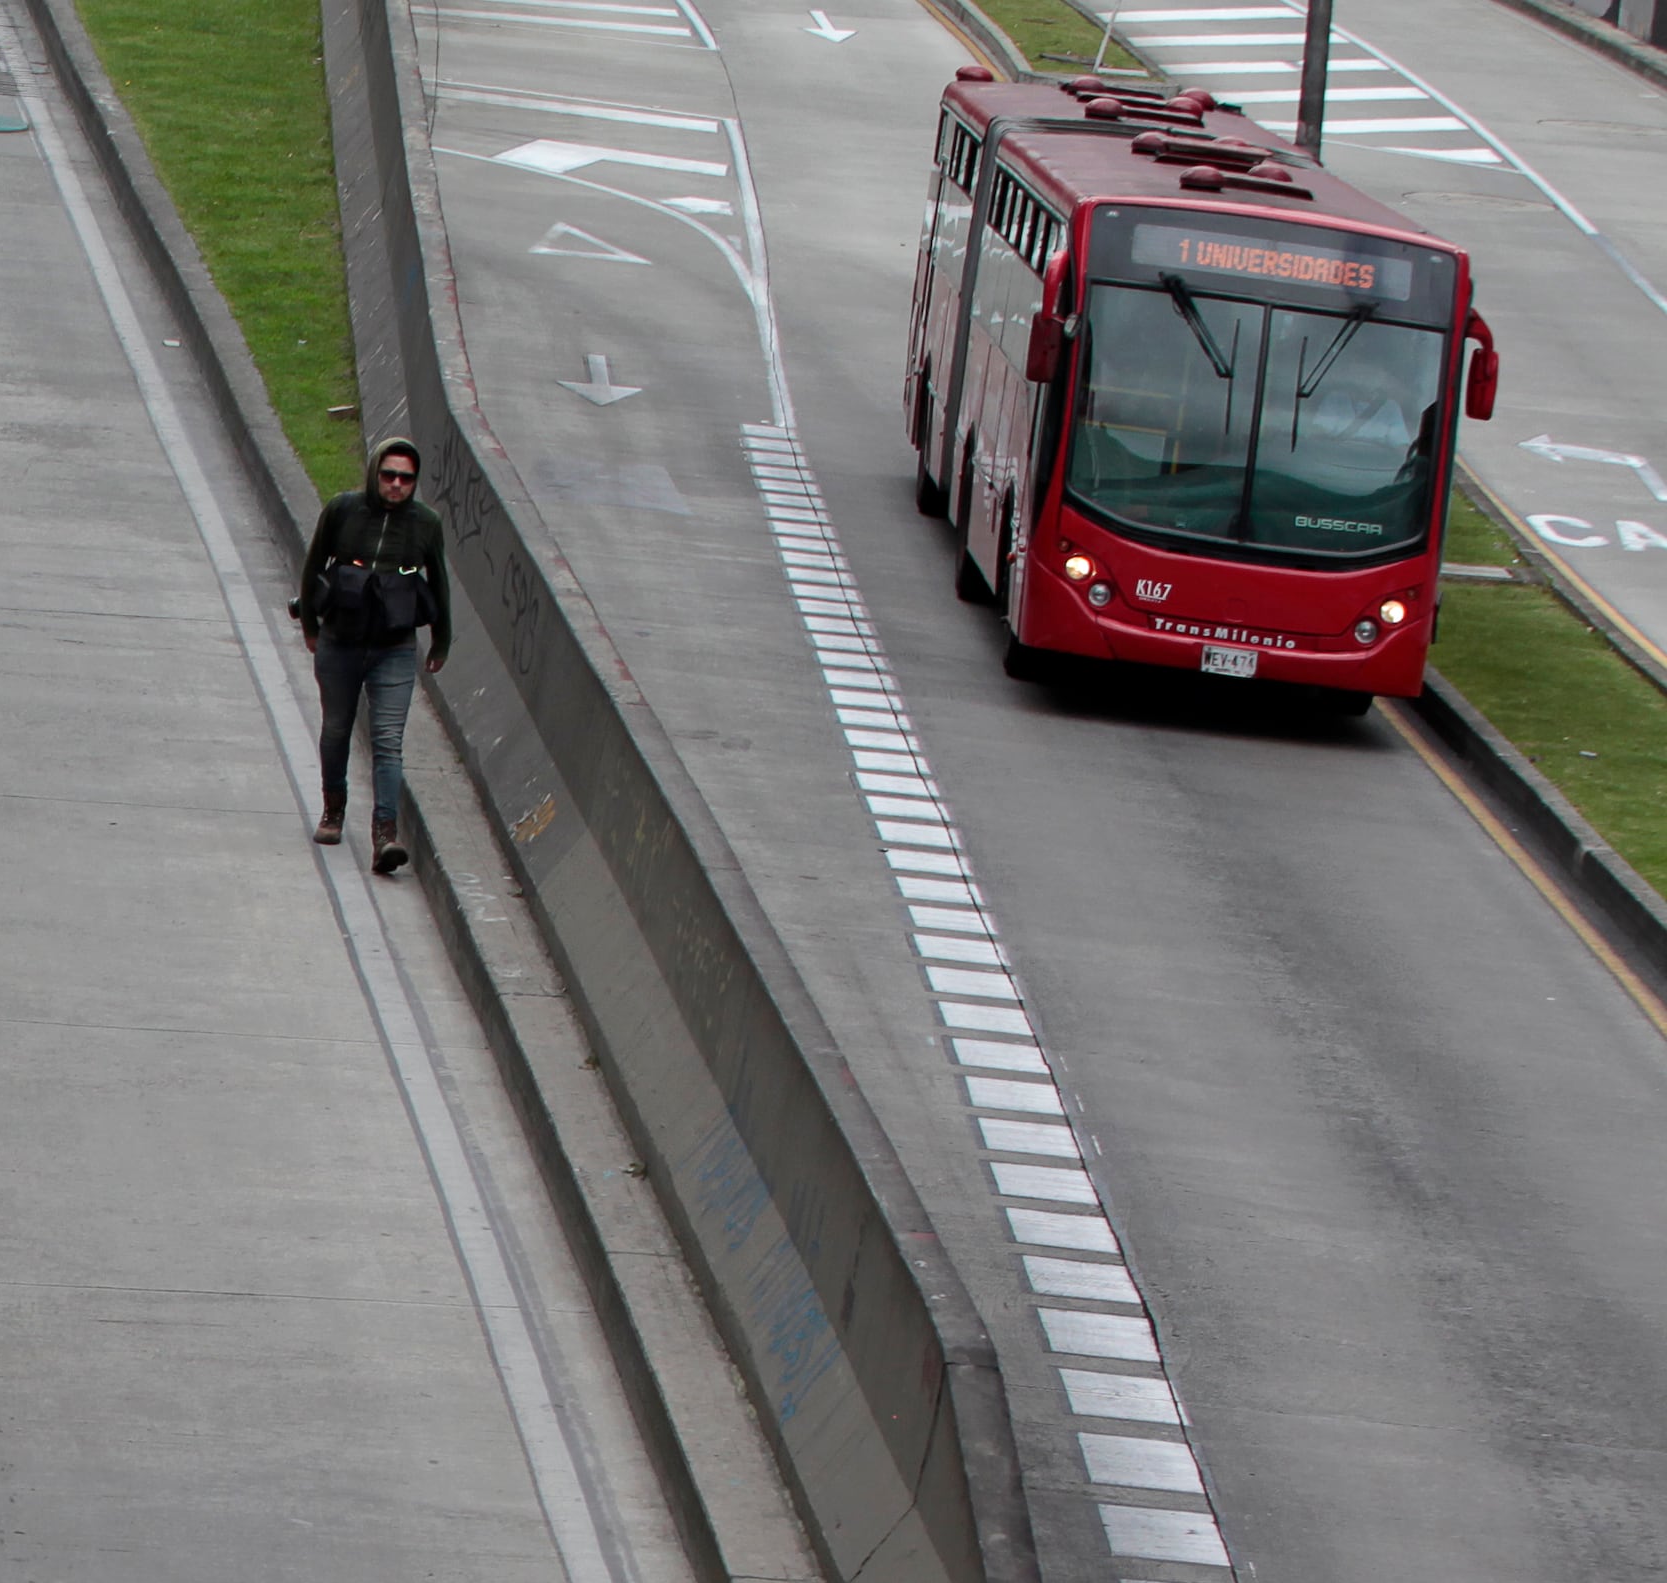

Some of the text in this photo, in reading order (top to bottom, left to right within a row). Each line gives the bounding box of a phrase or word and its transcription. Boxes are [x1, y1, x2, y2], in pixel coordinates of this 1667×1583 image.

[1179, 238, 1377, 289] 1 UNIVERSIDADES
[1294, 515, 1383, 536] BUSSCAR
[1135, 578, 1172, 601] K167
[1154, 617, 1296, 650] TransMilenio
